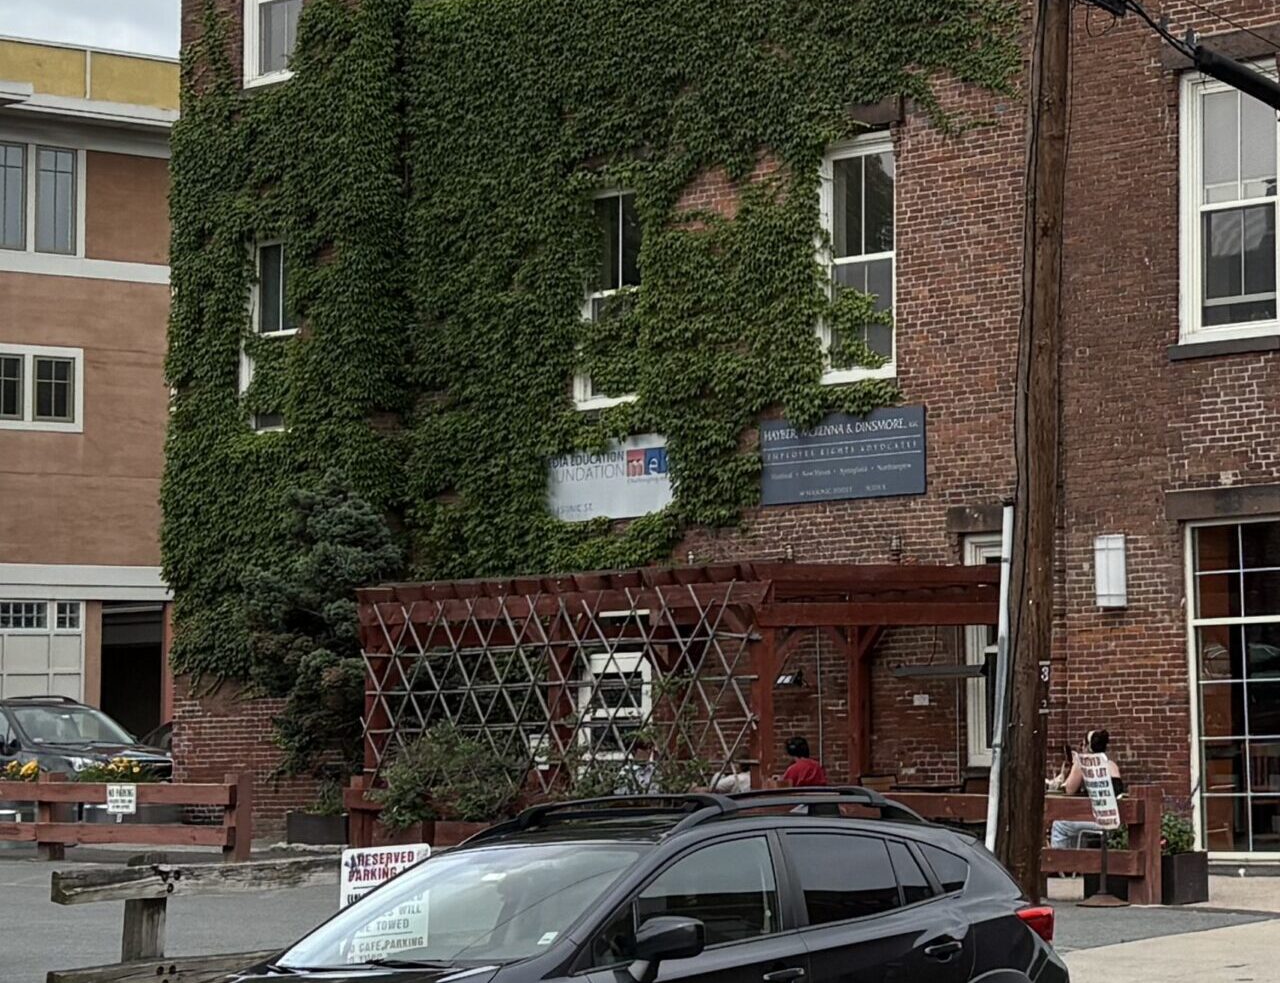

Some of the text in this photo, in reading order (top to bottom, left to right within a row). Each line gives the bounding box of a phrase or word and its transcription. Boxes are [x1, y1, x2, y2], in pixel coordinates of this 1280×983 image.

[846, 423, 853, 434] &
[356, 851, 415, 868] RESERVED
[347, 865, 398, 883] PARKING
[376, 918, 410, 931] TOWED
[385, 936, 424, 950] PARKING
